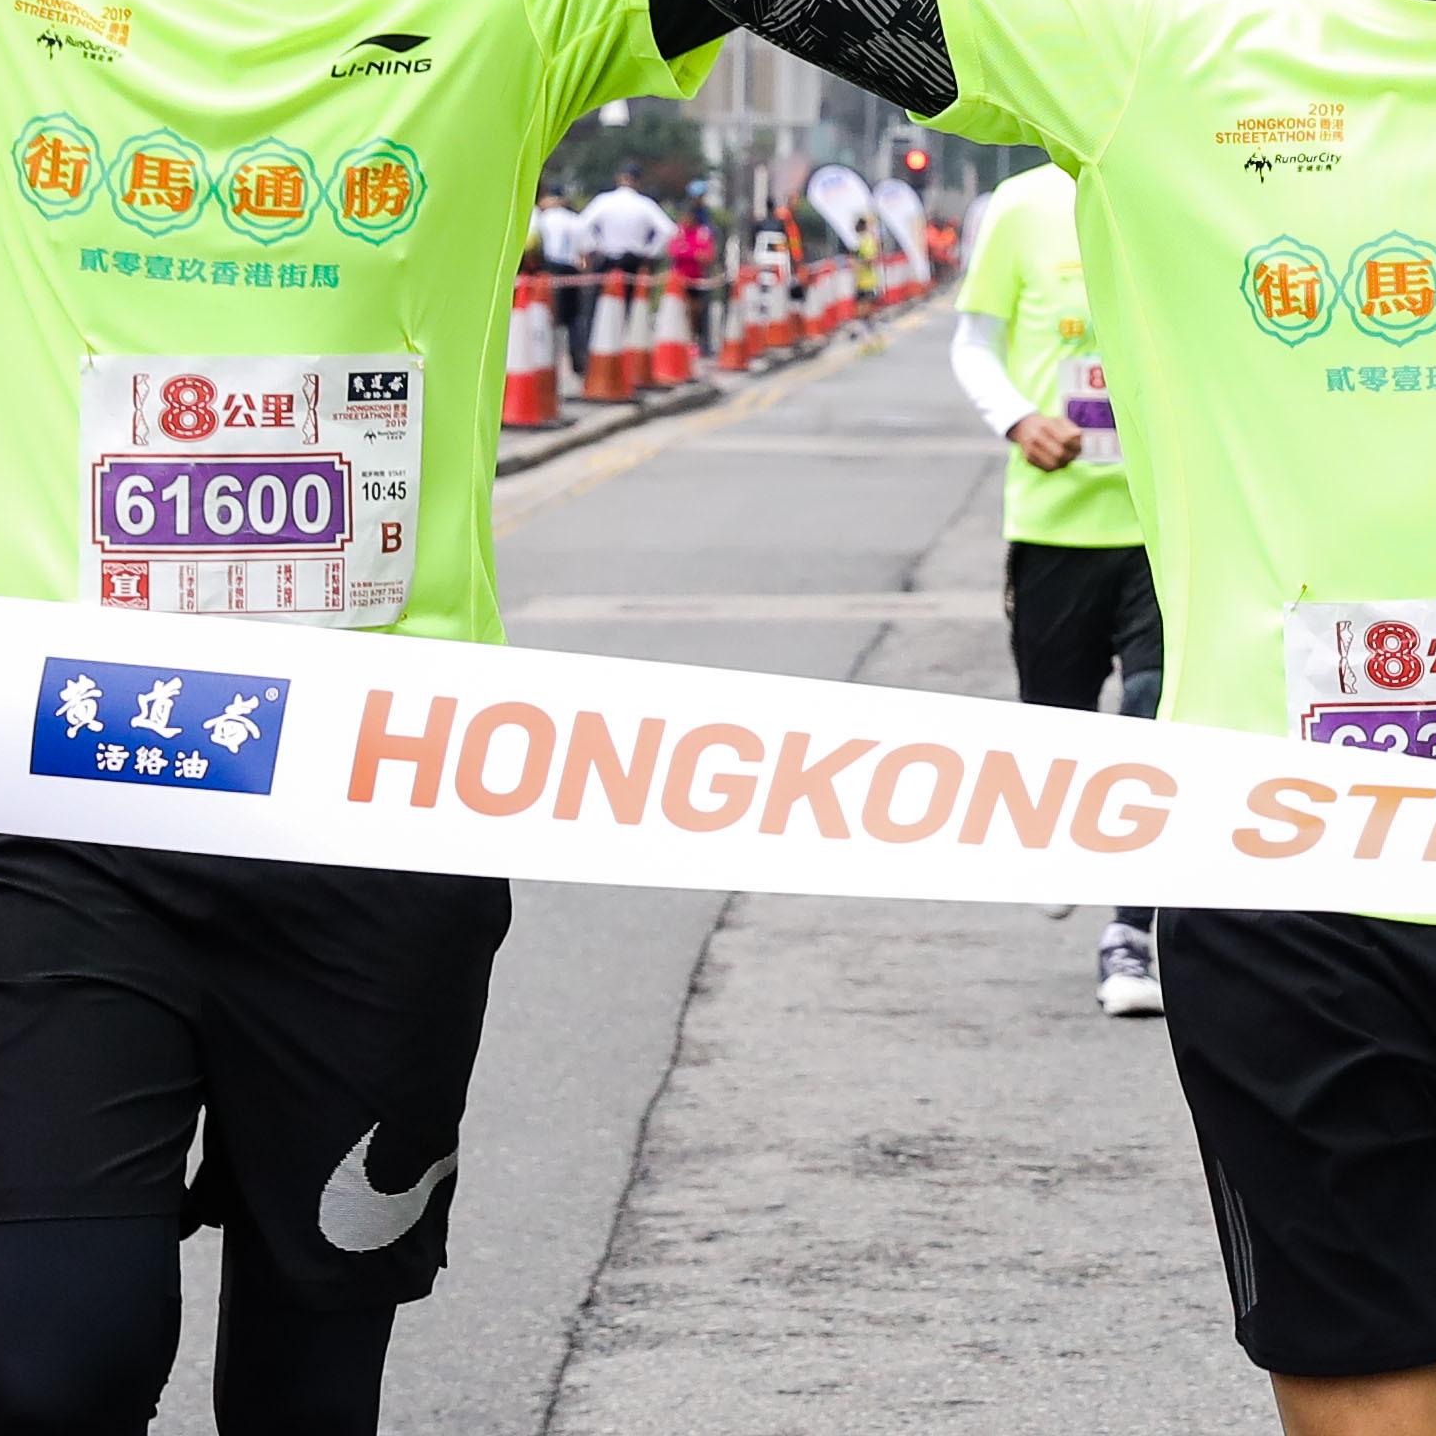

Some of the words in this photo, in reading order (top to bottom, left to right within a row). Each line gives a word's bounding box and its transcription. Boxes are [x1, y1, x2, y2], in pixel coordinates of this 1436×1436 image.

[100, 6, 132, 21] 2019
[331, 58, 432, 78] LI-NING
[1308, 103, 1345, 116] 2019
[1236, 117, 1316, 131] HONGKONG
[1215, 130, 1316, 144] STREETATHON
[1274, 152, 1342, 165] RunOurCity
[22, 133, 412, 219] 街馬通勝
[79, 247, 341, 290] 貳零壹玖香港街馬
[385, 419, 407, 428] 2019
[362, 481, 407, 501] 10:45
[115, 473, 332, 536] 61600
[381, 521, 403, 554] B
[94, 742, 210, 781] 活絡油
[347, 689, 1178, 855] HONGKONG
